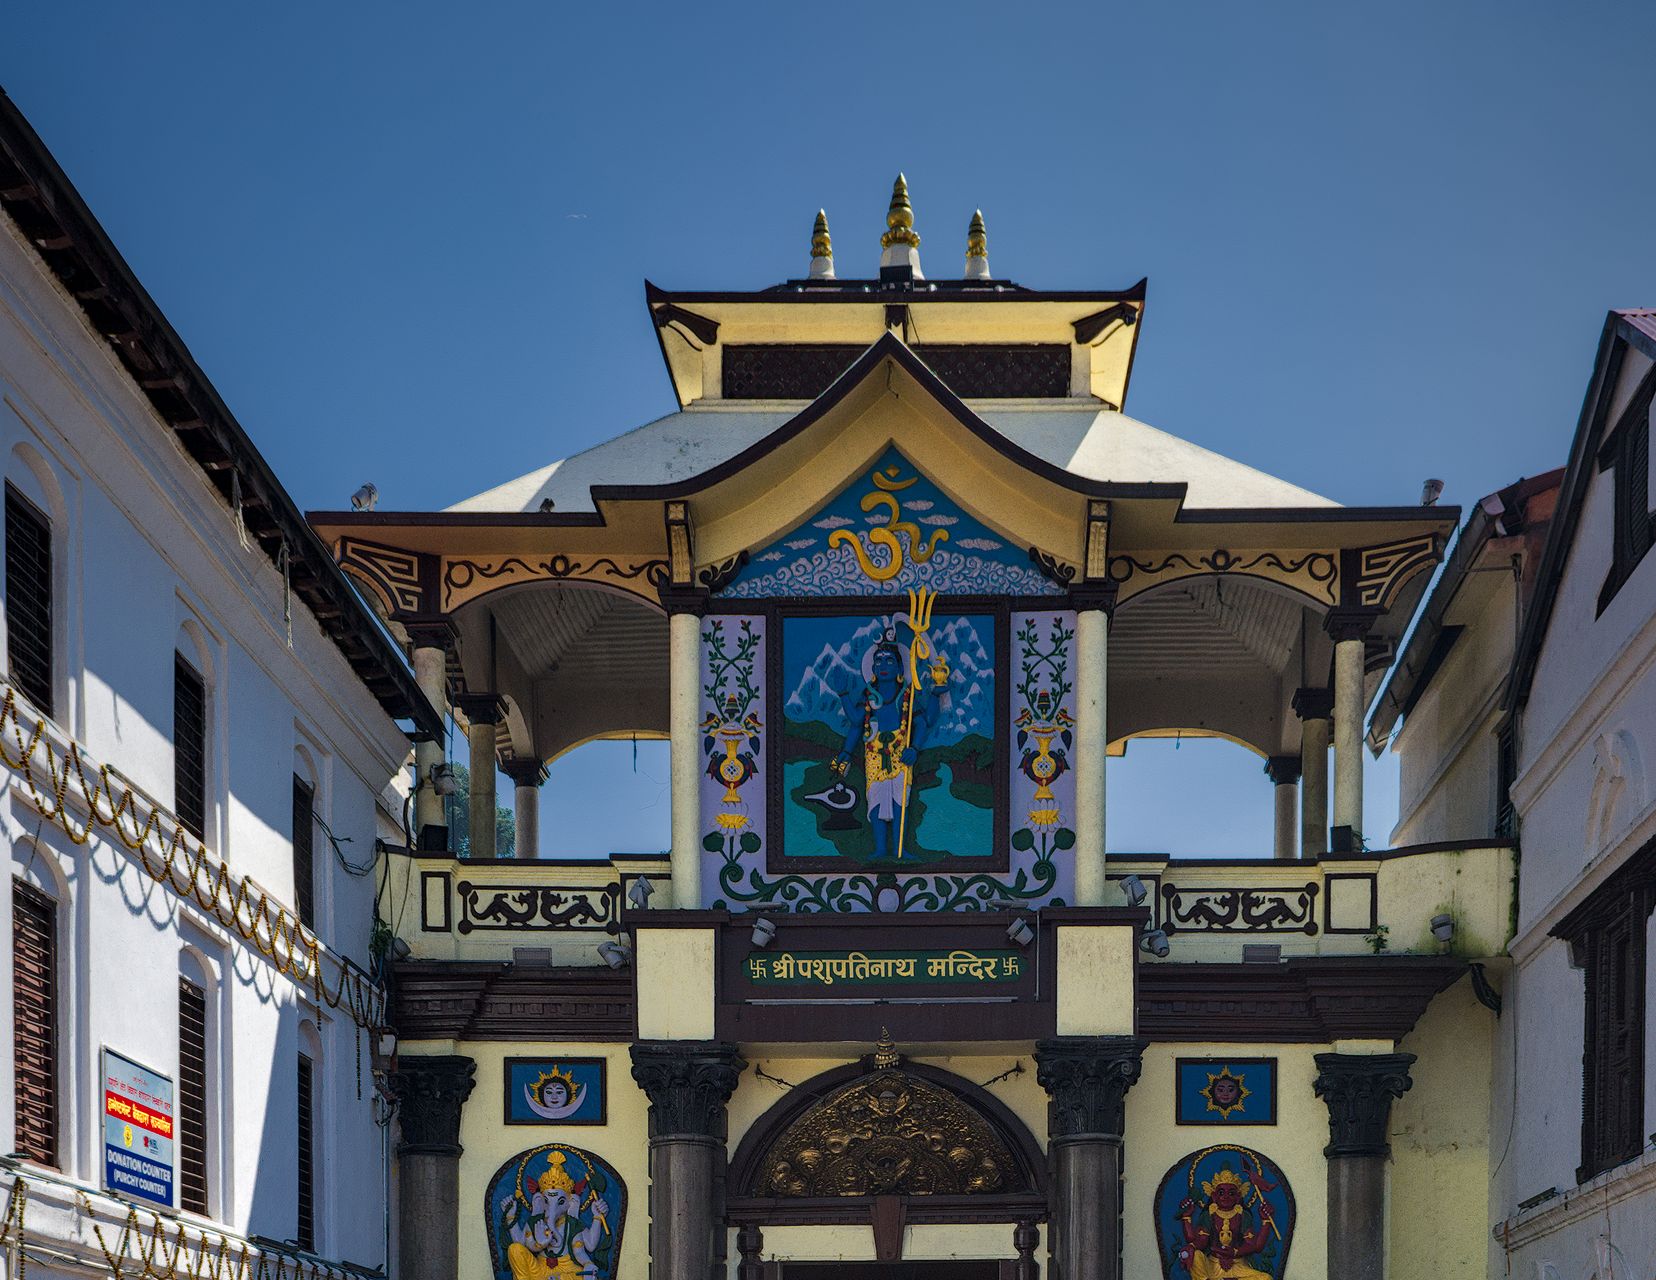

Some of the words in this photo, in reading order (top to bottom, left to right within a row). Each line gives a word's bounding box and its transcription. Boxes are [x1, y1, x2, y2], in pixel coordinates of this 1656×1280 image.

[927, 950, 998, 981] मन्दिर
[107, 1149, 141, 1172] DONATION
[142, 1161, 171, 1183] COUNTER
[139, 1176, 166, 1198] COUNTER)
